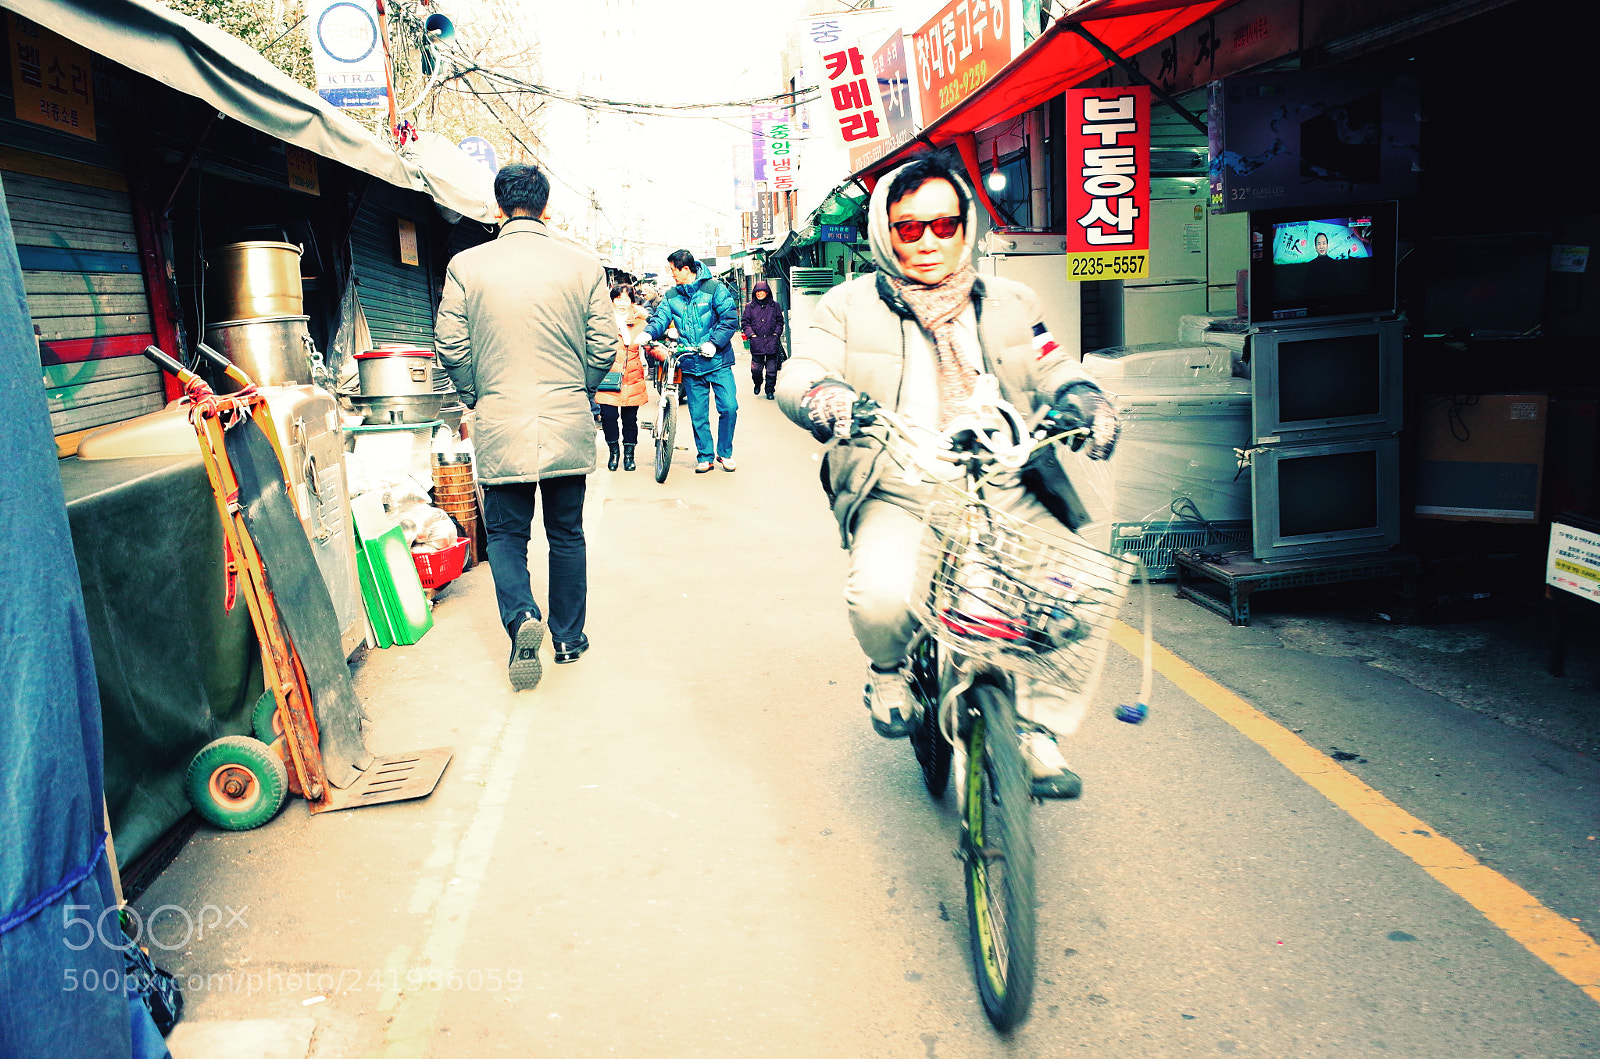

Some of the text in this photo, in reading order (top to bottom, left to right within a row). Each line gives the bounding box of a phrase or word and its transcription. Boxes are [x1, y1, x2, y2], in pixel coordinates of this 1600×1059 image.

[17, 41, 89, 106] 벨소리
[328, 74, 376, 85] KTRA
[823, 46, 880, 142] 카메라
[939, 59, 988, 108] 2252-9259
[40, 98, 79, 129] 각종소품
[770, 123, 795, 190] 중앙냉동
[1077, 94, 1139, 246] 부동산
[1072, 255, 1145, 276] 2235-5557
